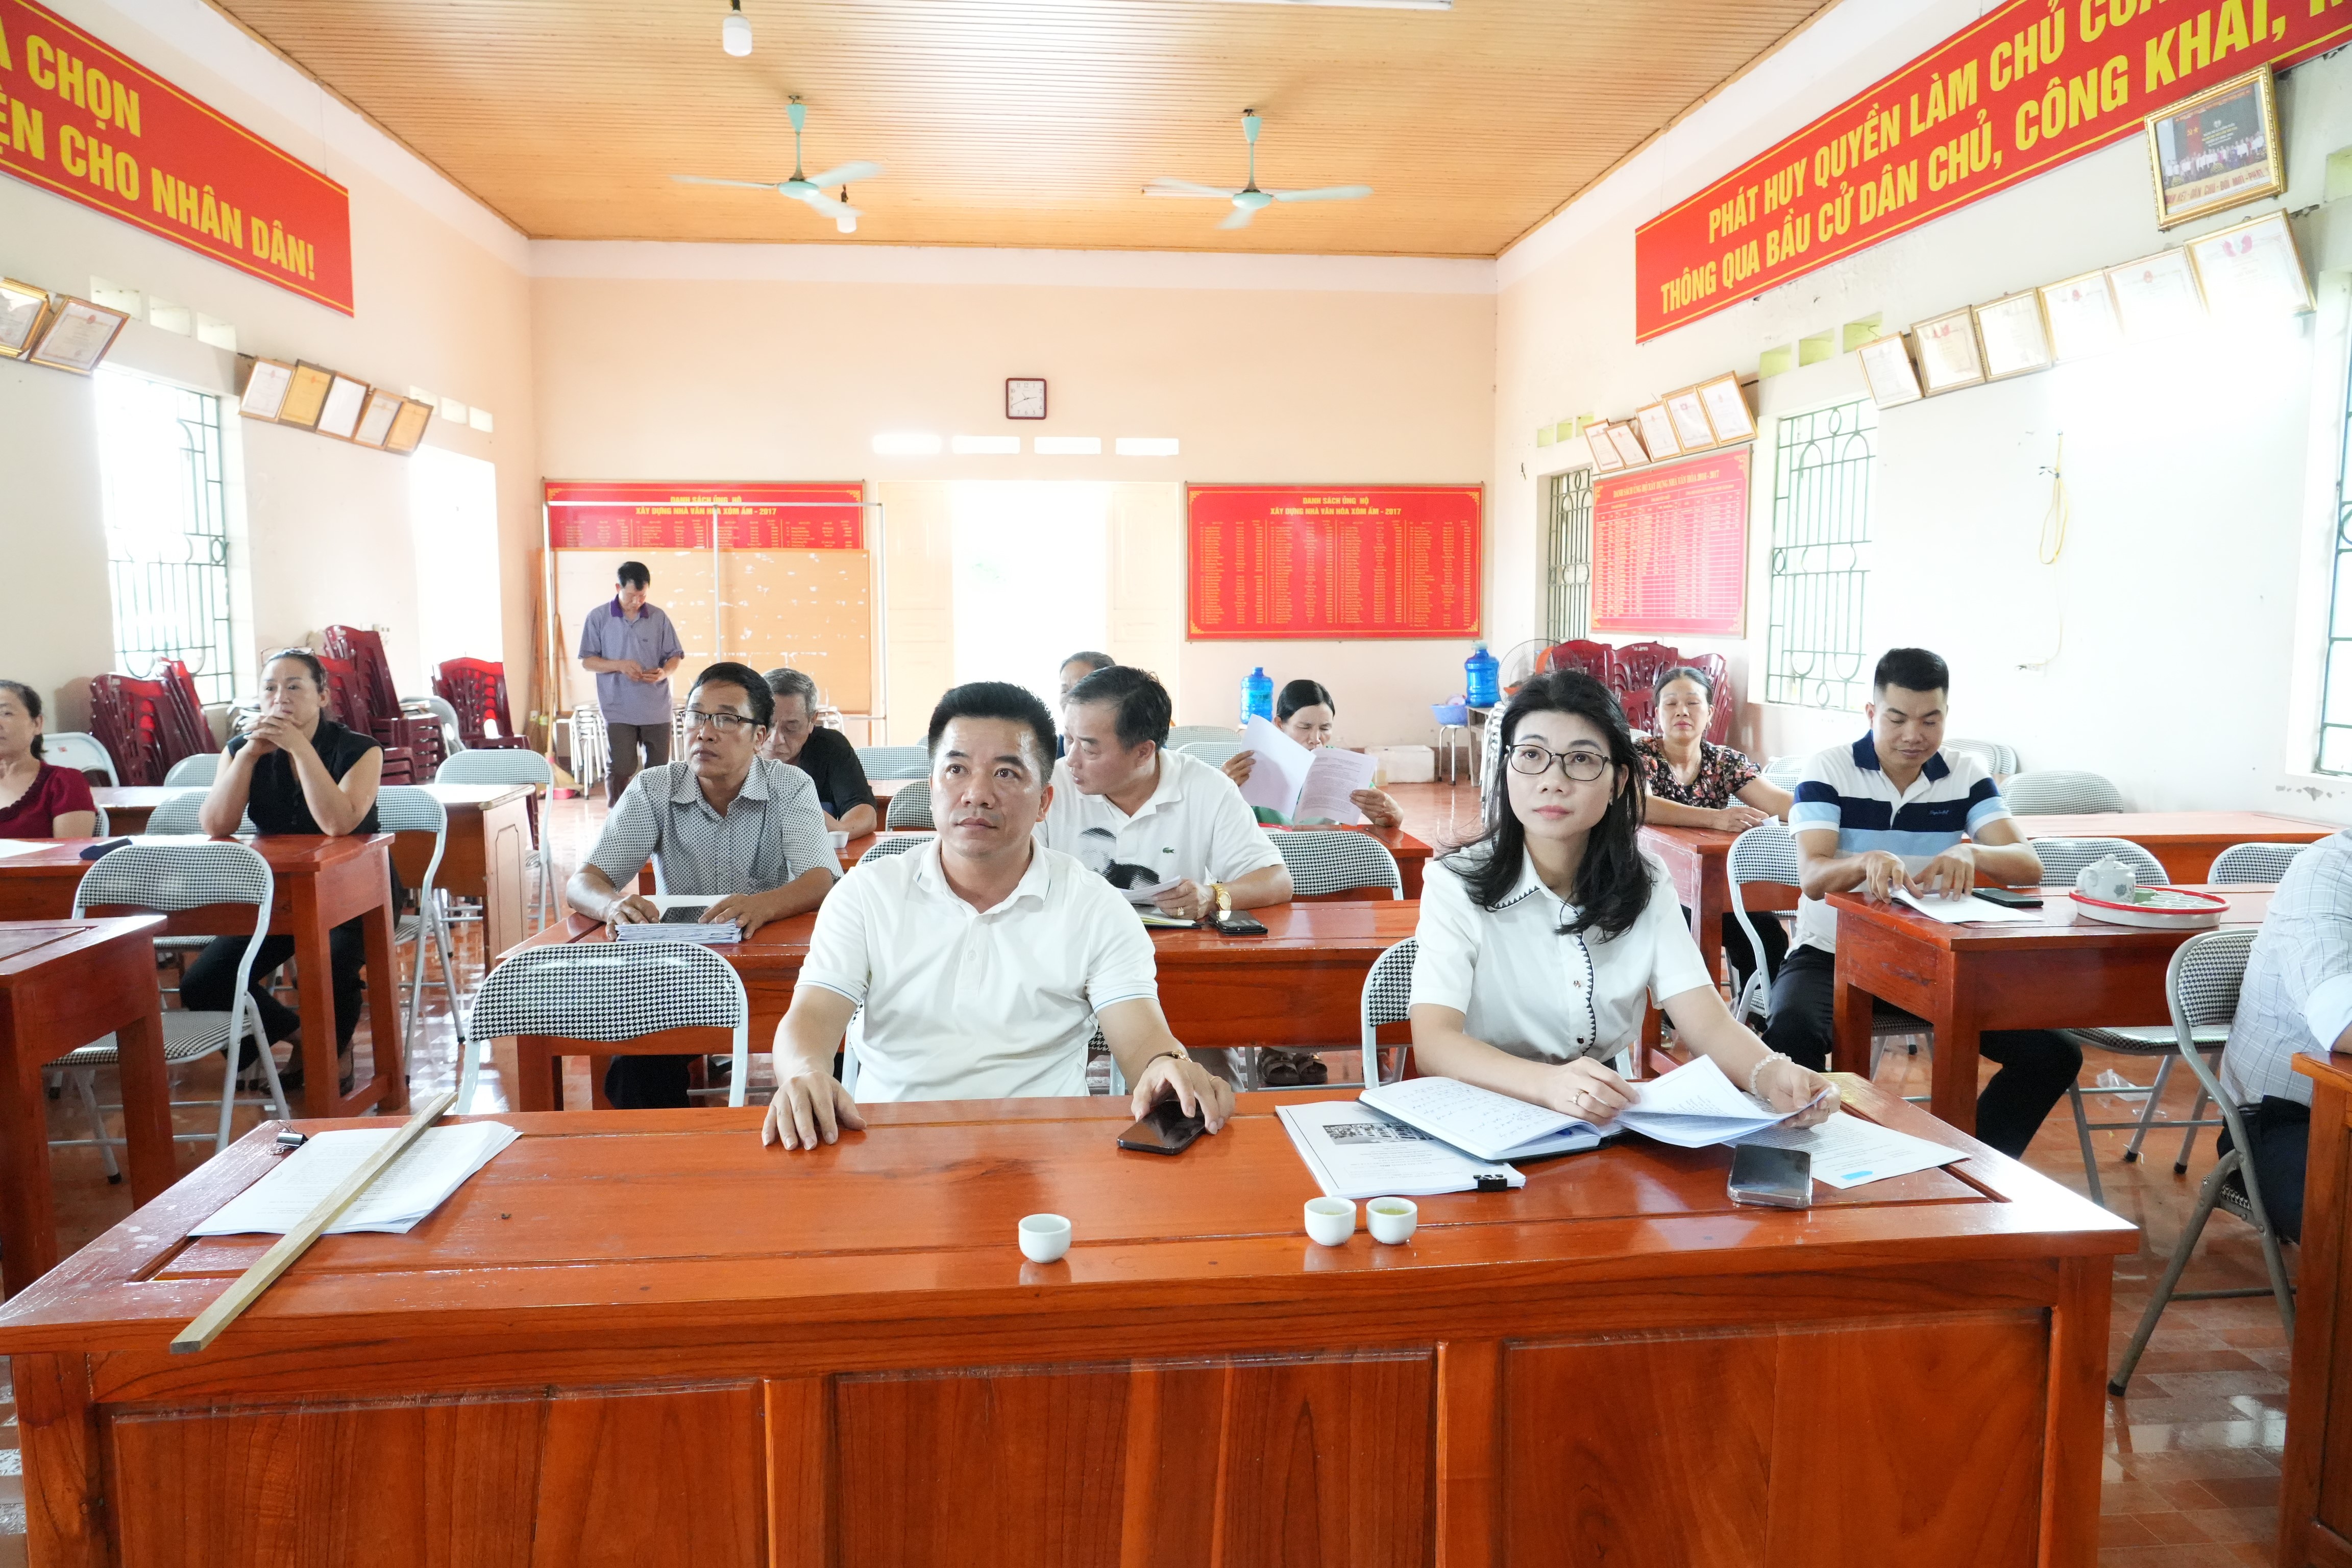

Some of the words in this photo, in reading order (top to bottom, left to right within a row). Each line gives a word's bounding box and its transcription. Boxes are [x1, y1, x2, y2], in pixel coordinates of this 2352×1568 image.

[27, 34, 140, 138] CHỌN
[1709, 183, 1759, 243] PHÁT
[1764, 158, 1808, 214] HUY
[1814, 103, 1901, 188] QUYỀN
[1910, 73, 1978, 138] LÀM
[1990, 0, 2065, 92] CHỦ
[59, 125, 140, 201] CHO
[151, 166, 243, 250] NHÂN
[251, 219, 315, 281] DÂN!
[1660, 268, 1717, 314] THÔNG
[1722, 239, 1760, 290] QUA
[1766, 208, 1810, 267] BẦU
[1818, 184, 1854, 243] CỬ
[1859, 163, 1918, 225] DÂN
[1928, 108, 2002, 193] CHỦ,
[2015, 77, 2128, 151] CÔNG
[2145, 0, 2286, 93] KHAI,
[636, 506, 650, 514] XÂY
[651, 506, 671, 516] DỰNG
[673, 506, 689, 514] NHÀ
[690, 506, 705, 514] VĂN
[723, 506, 740, 514] XÓM
[1285, 507, 1304, 516] DỰNG
[1305, 506, 1319, 514] NHÀ
[1360, 496, 1369, 505] HỘ
